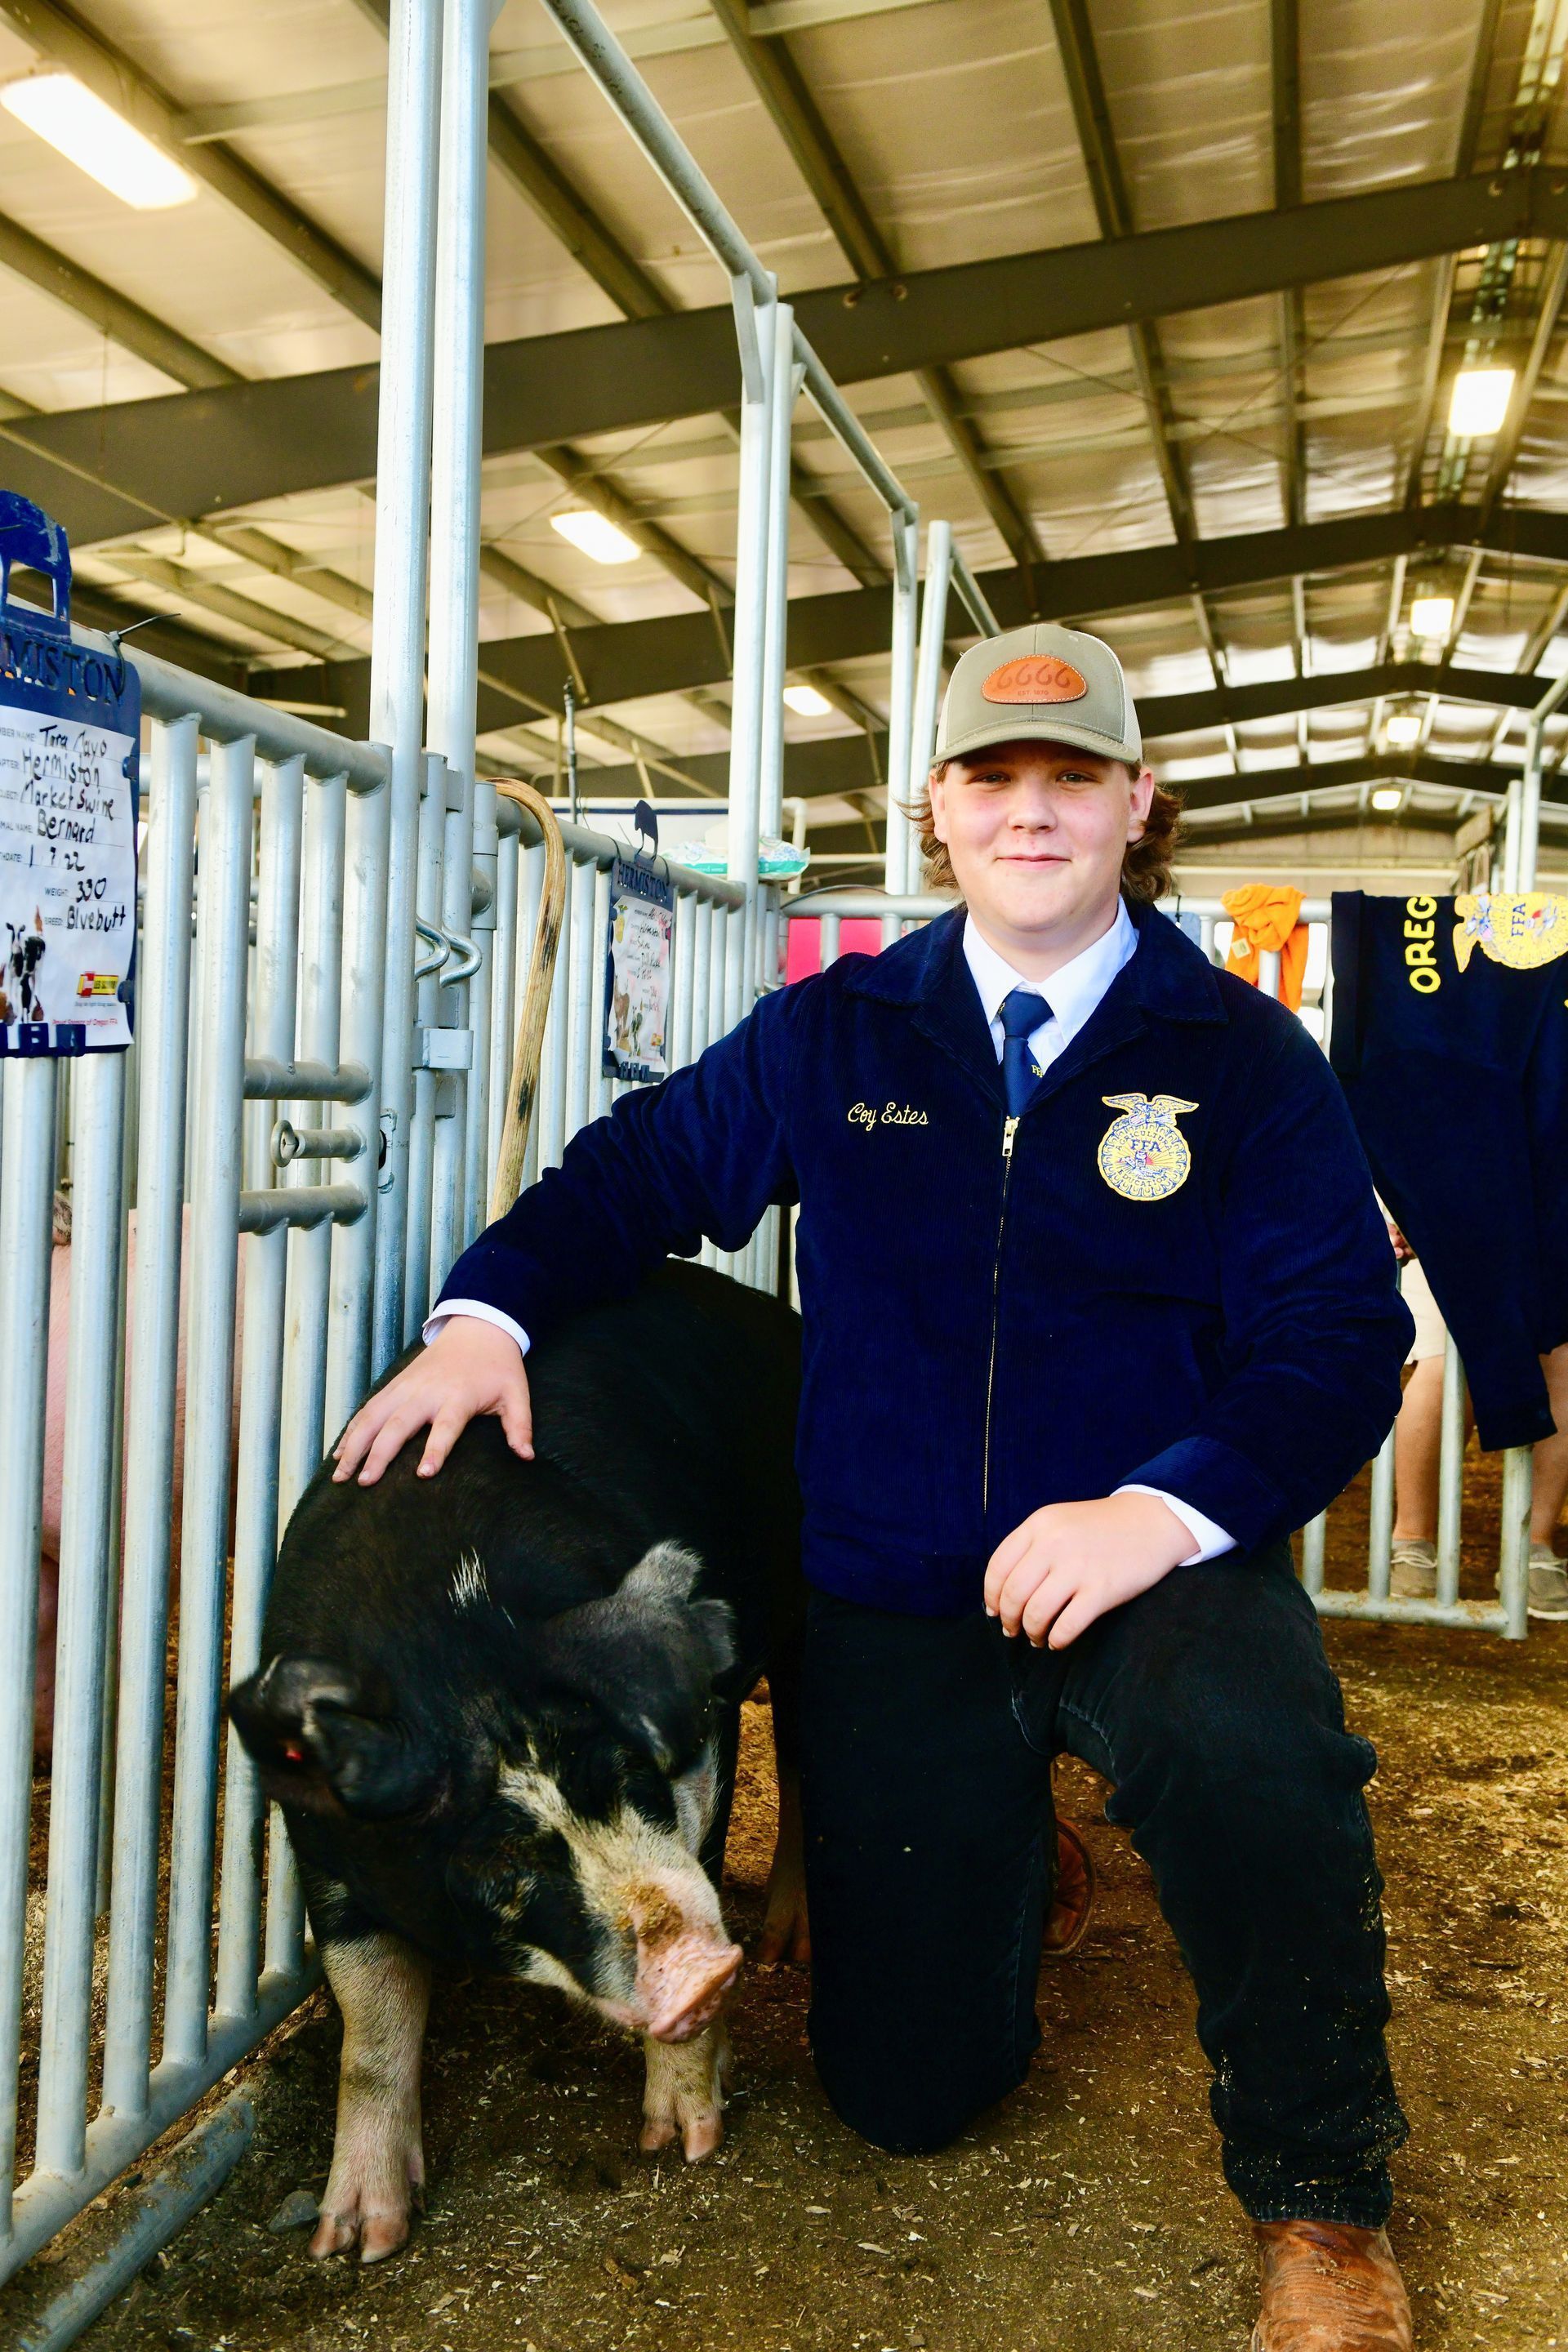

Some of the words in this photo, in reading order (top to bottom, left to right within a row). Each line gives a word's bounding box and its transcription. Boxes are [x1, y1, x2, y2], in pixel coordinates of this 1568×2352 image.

[0, 634, 124, 704] MISTON
[996, 663, 1071, 690] 6666
[23, 747, 100, 787] Hermiston
[20, 779, 74, 810] Market
[38, 808, 96, 844] Bernard
[618, 860, 668, 903] HERMISTON
[1511, 902, 1526, 937] FFA
[847, 1102, 877, 1132] Coy
[880, 1102, 929, 1125] Estes
[1116, 1130, 1174, 1156] AGRICULTURAL
[1130, 1139, 1162, 1153] FFA
[1117, 1169, 1169, 1187] EDUCATION
